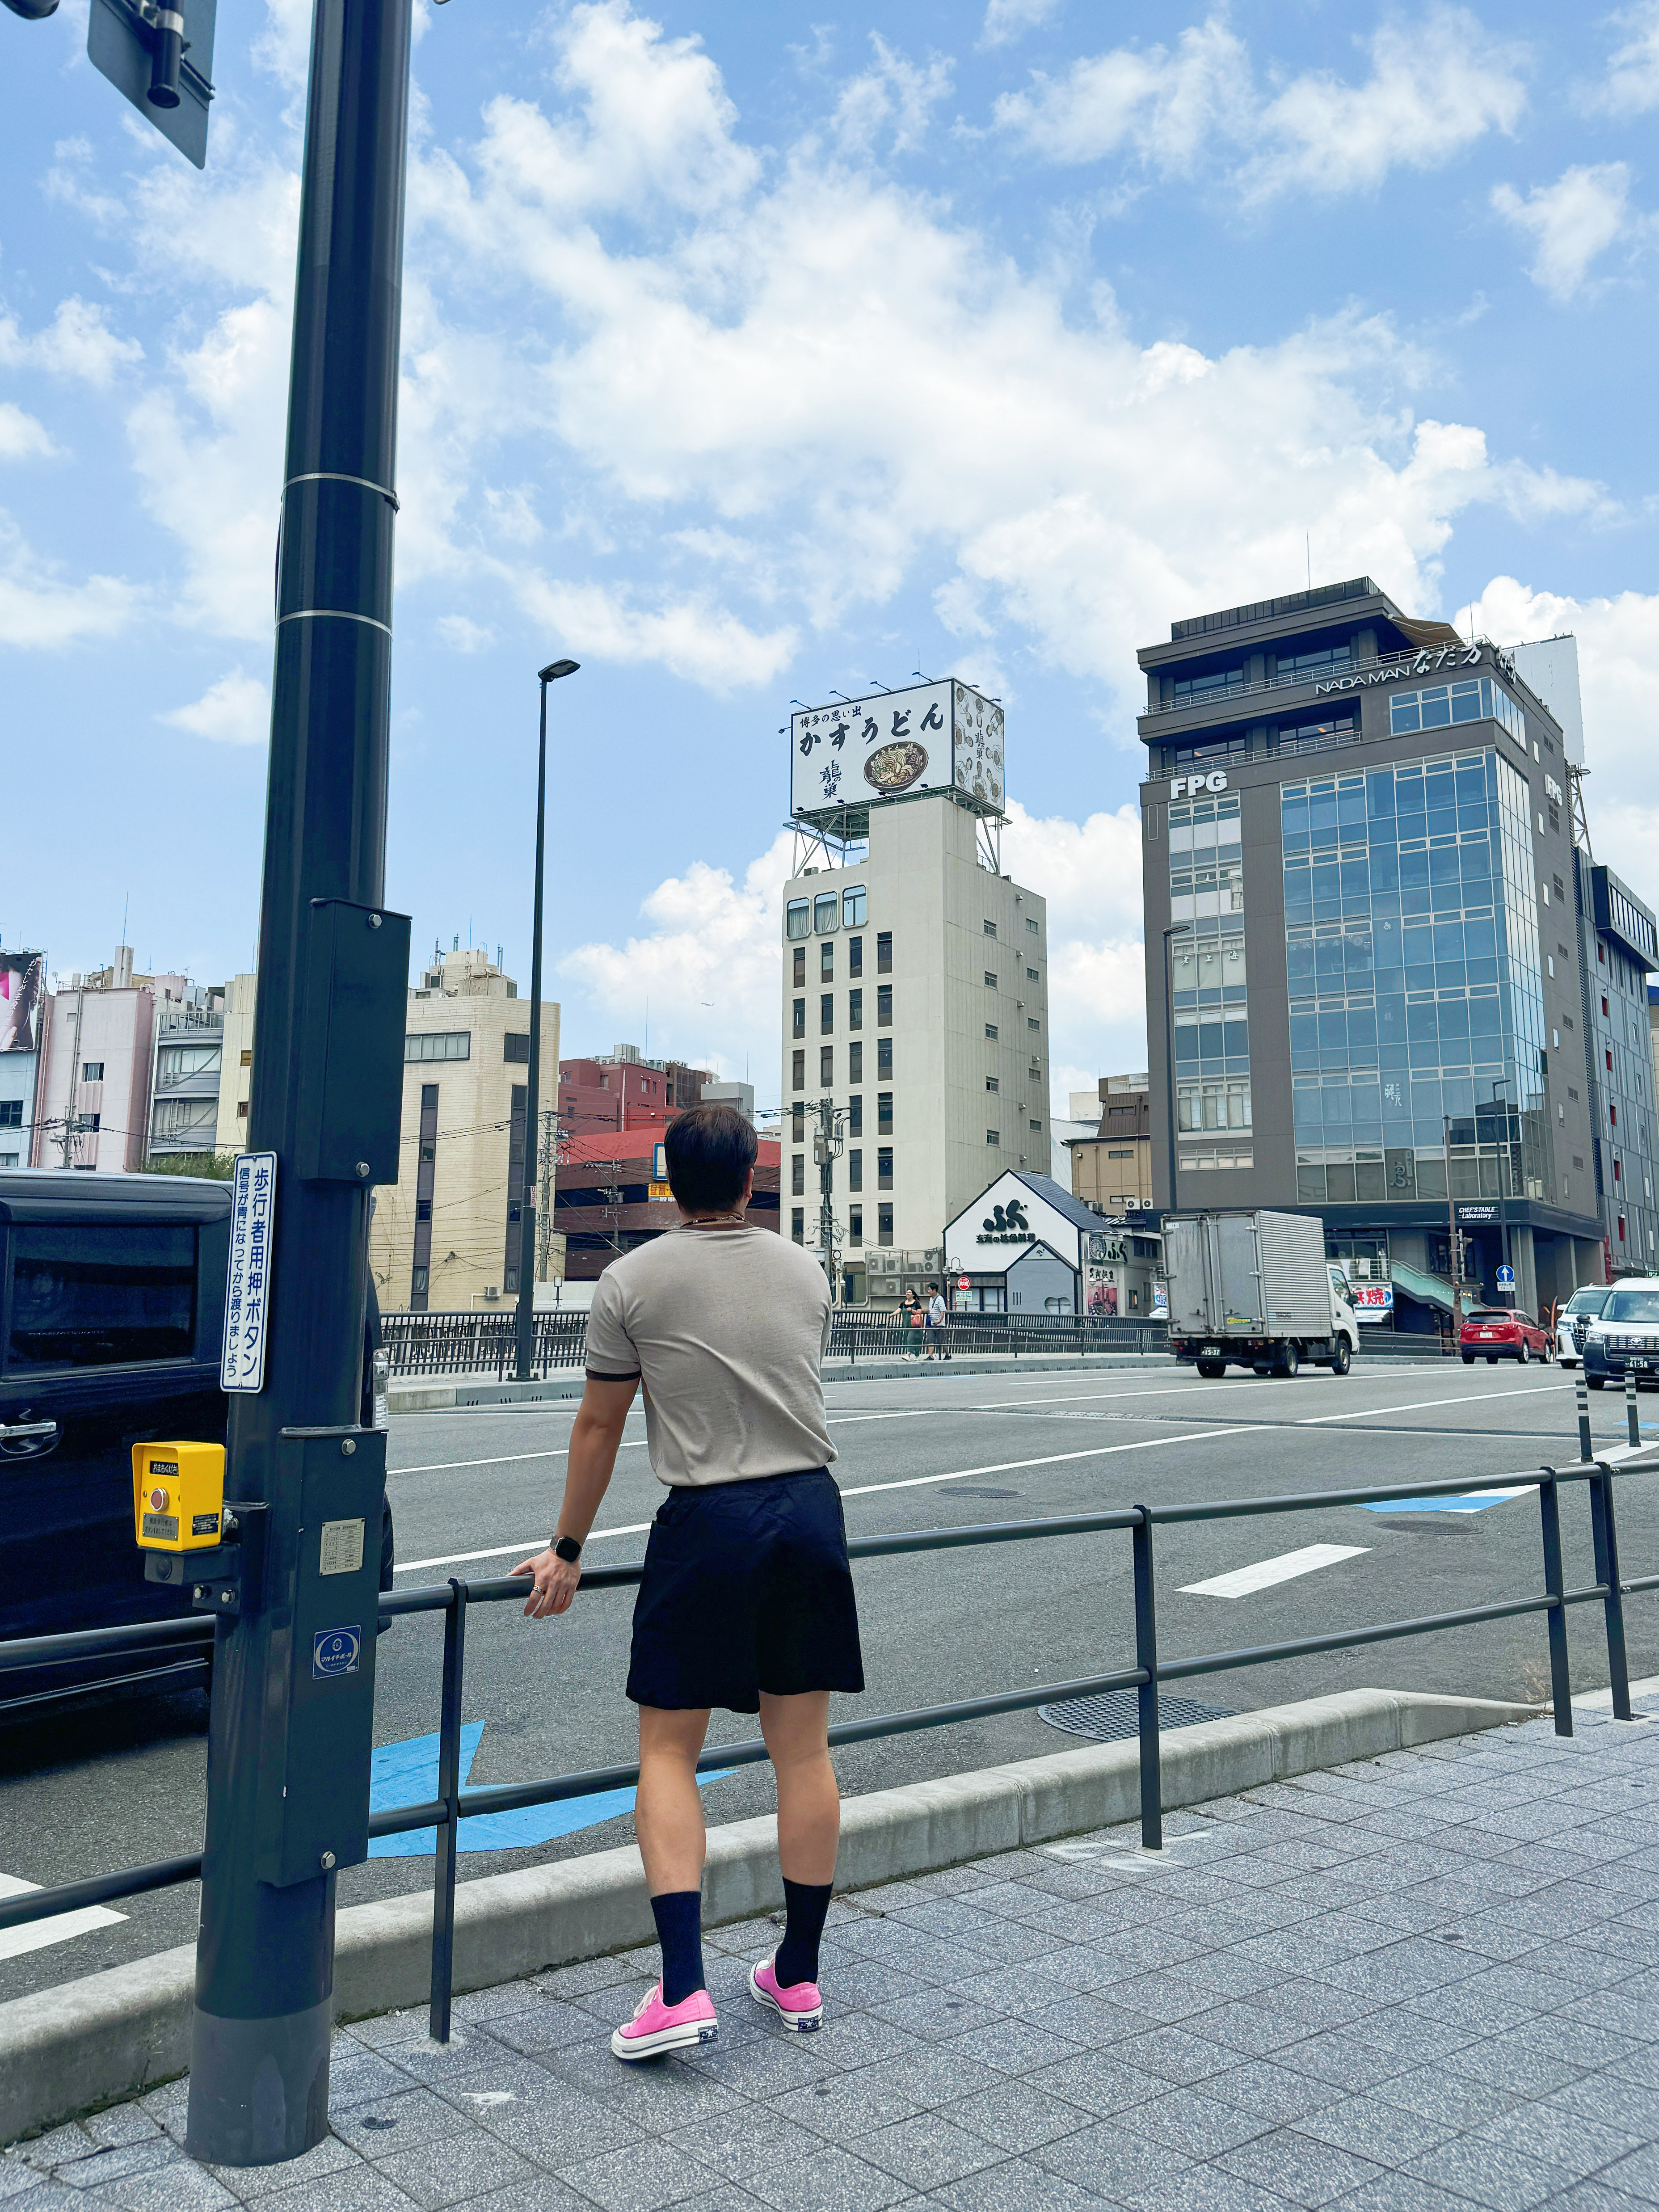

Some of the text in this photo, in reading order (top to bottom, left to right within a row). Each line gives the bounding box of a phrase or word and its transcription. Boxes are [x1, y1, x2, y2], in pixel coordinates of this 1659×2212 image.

[1412, 639, 1483, 674] なだ万
[800, 705, 862, 729] 博多の思い出
[800, 702, 944, 757] かすうどん
[819, 759, 842, 801] 龍の巣
[1170, 770, 1228, 800] FPG
[1545, 774, 1562, 806] FPG
[982, 1199, 1029, 1231] ふぐ
[242, 1167, 269, 1377] 歩行者用押ボタン
